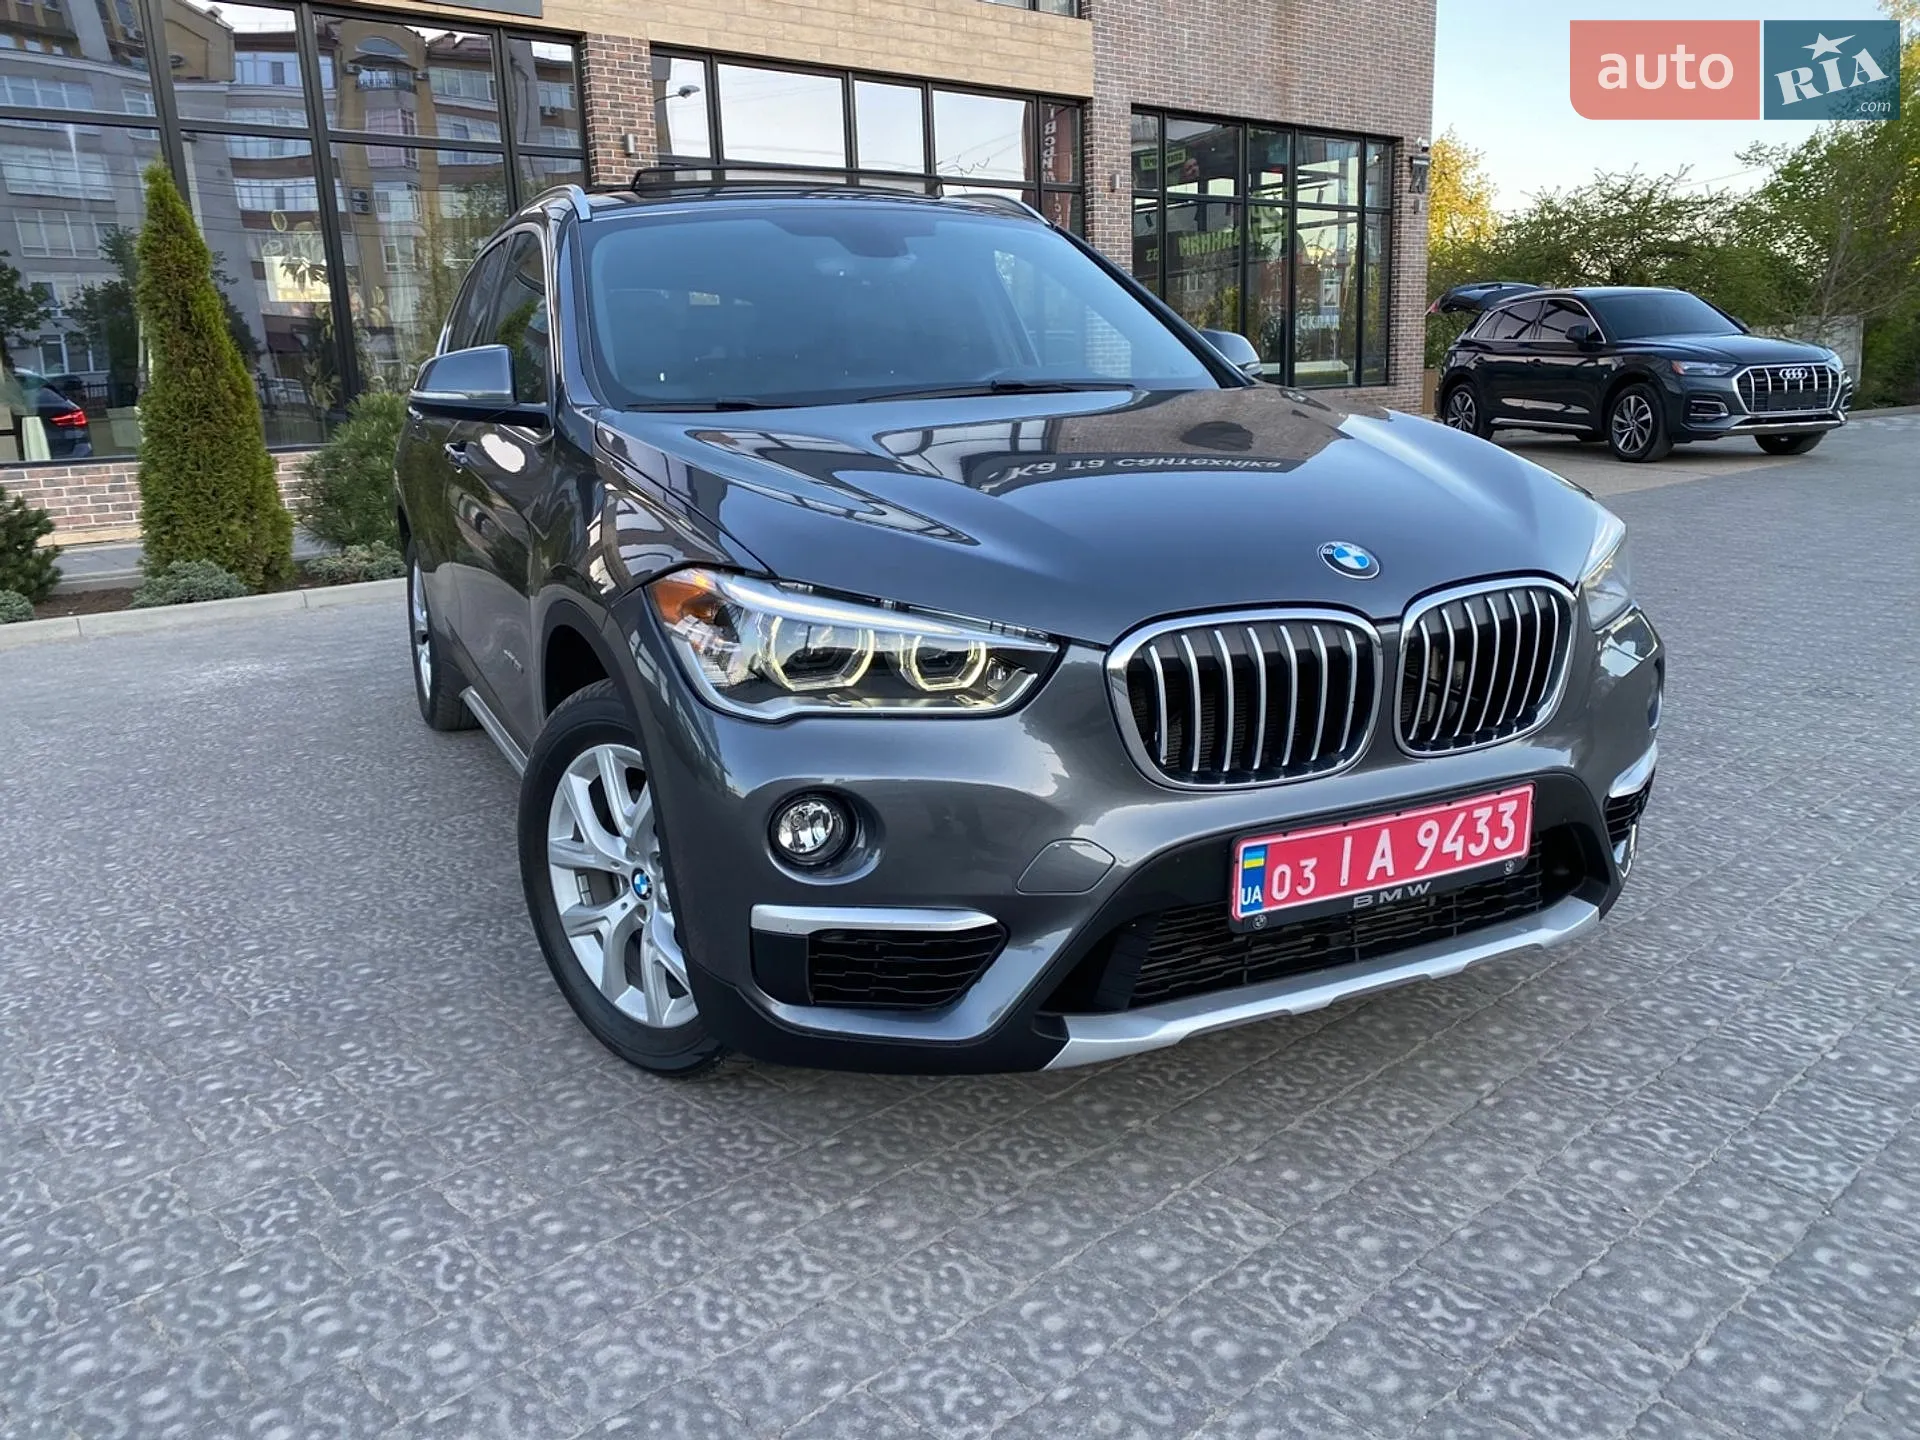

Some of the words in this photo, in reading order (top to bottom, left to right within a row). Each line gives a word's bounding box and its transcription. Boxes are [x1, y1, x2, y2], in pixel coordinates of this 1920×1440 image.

[1271, 857, 1318, 901] 03
[1414, 799, 1519, 872] 9433
[1241, 885, 1263, 906] UA
[1353, 881, 1432, 909] BMW
